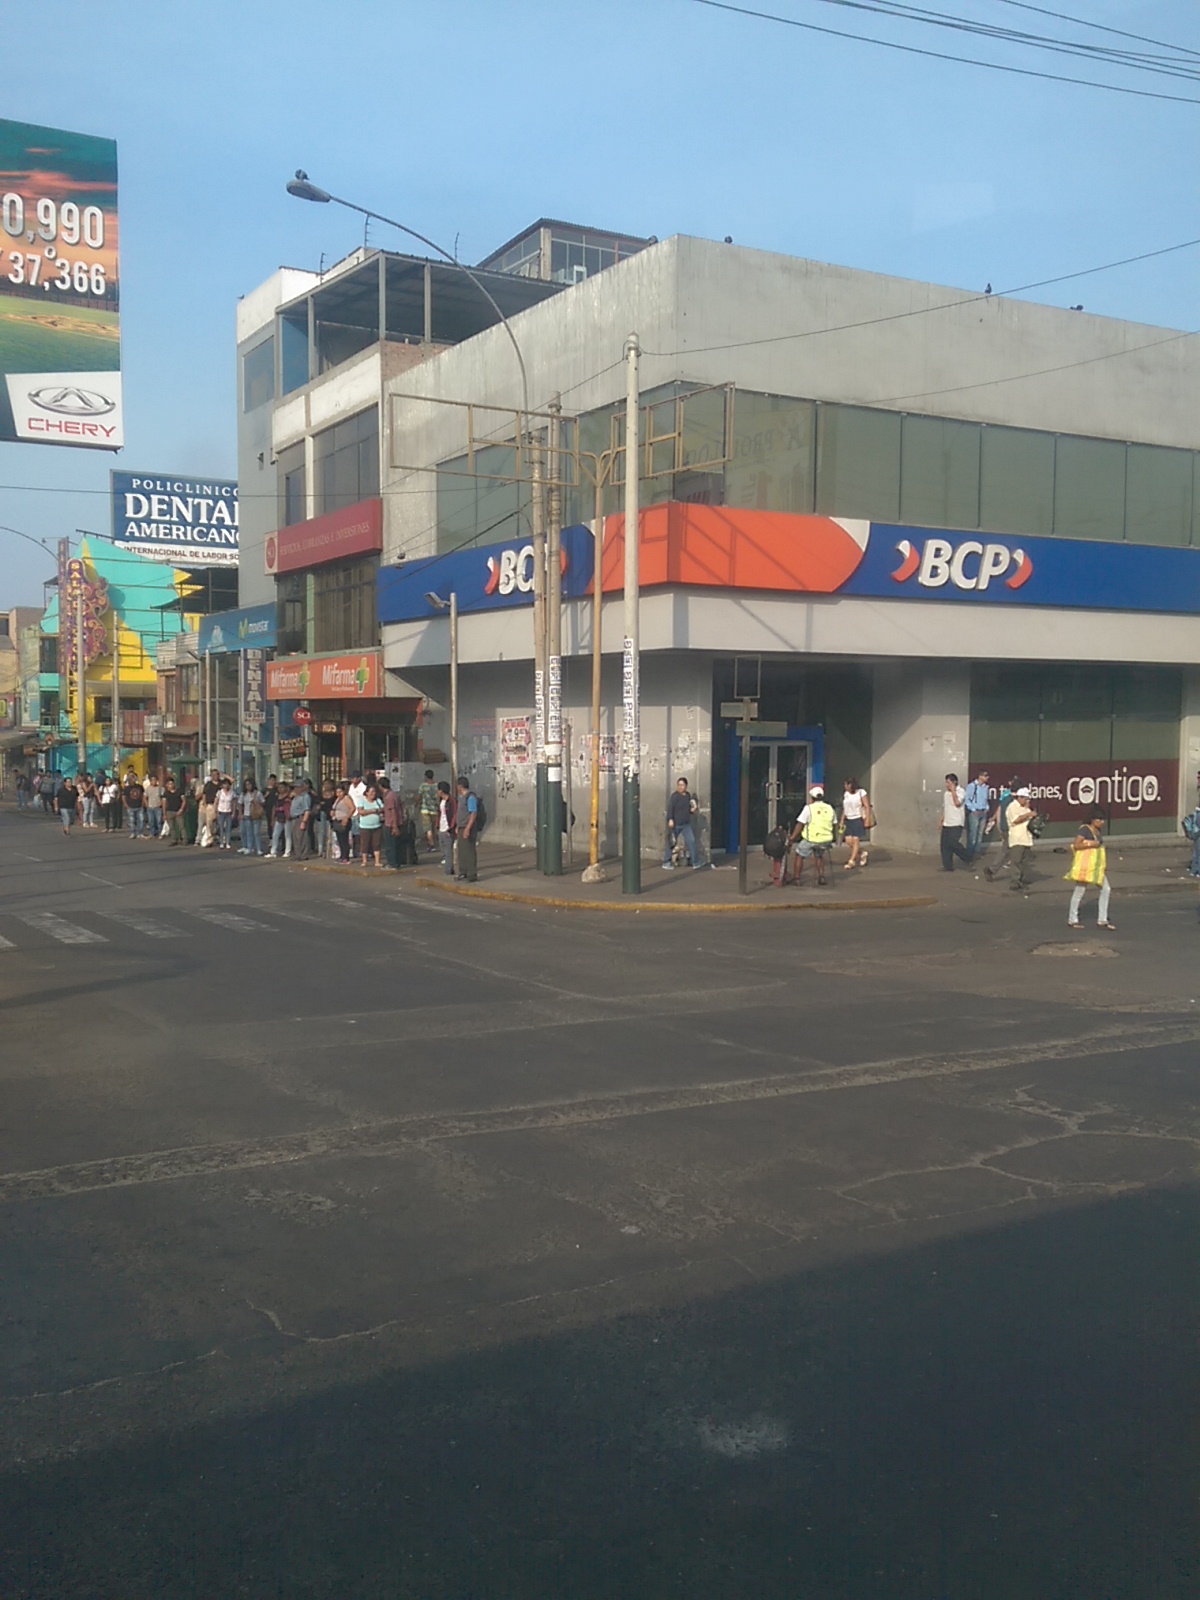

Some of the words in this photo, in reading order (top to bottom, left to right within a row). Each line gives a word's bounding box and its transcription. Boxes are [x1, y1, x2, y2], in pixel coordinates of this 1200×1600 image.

[28, 417, 116, 437] CHERY
[189, 550, 200, 558] DE
[202, 551, 227, 560] LABOR
[918, 539, 1010, 590] BCP
[499, 543, 549, 595] BC
[271, 668, 298, 688] Mifarma
[322, 663, 355, 686] Mifarma
[1066, 767, 1161, 811] contigo.
